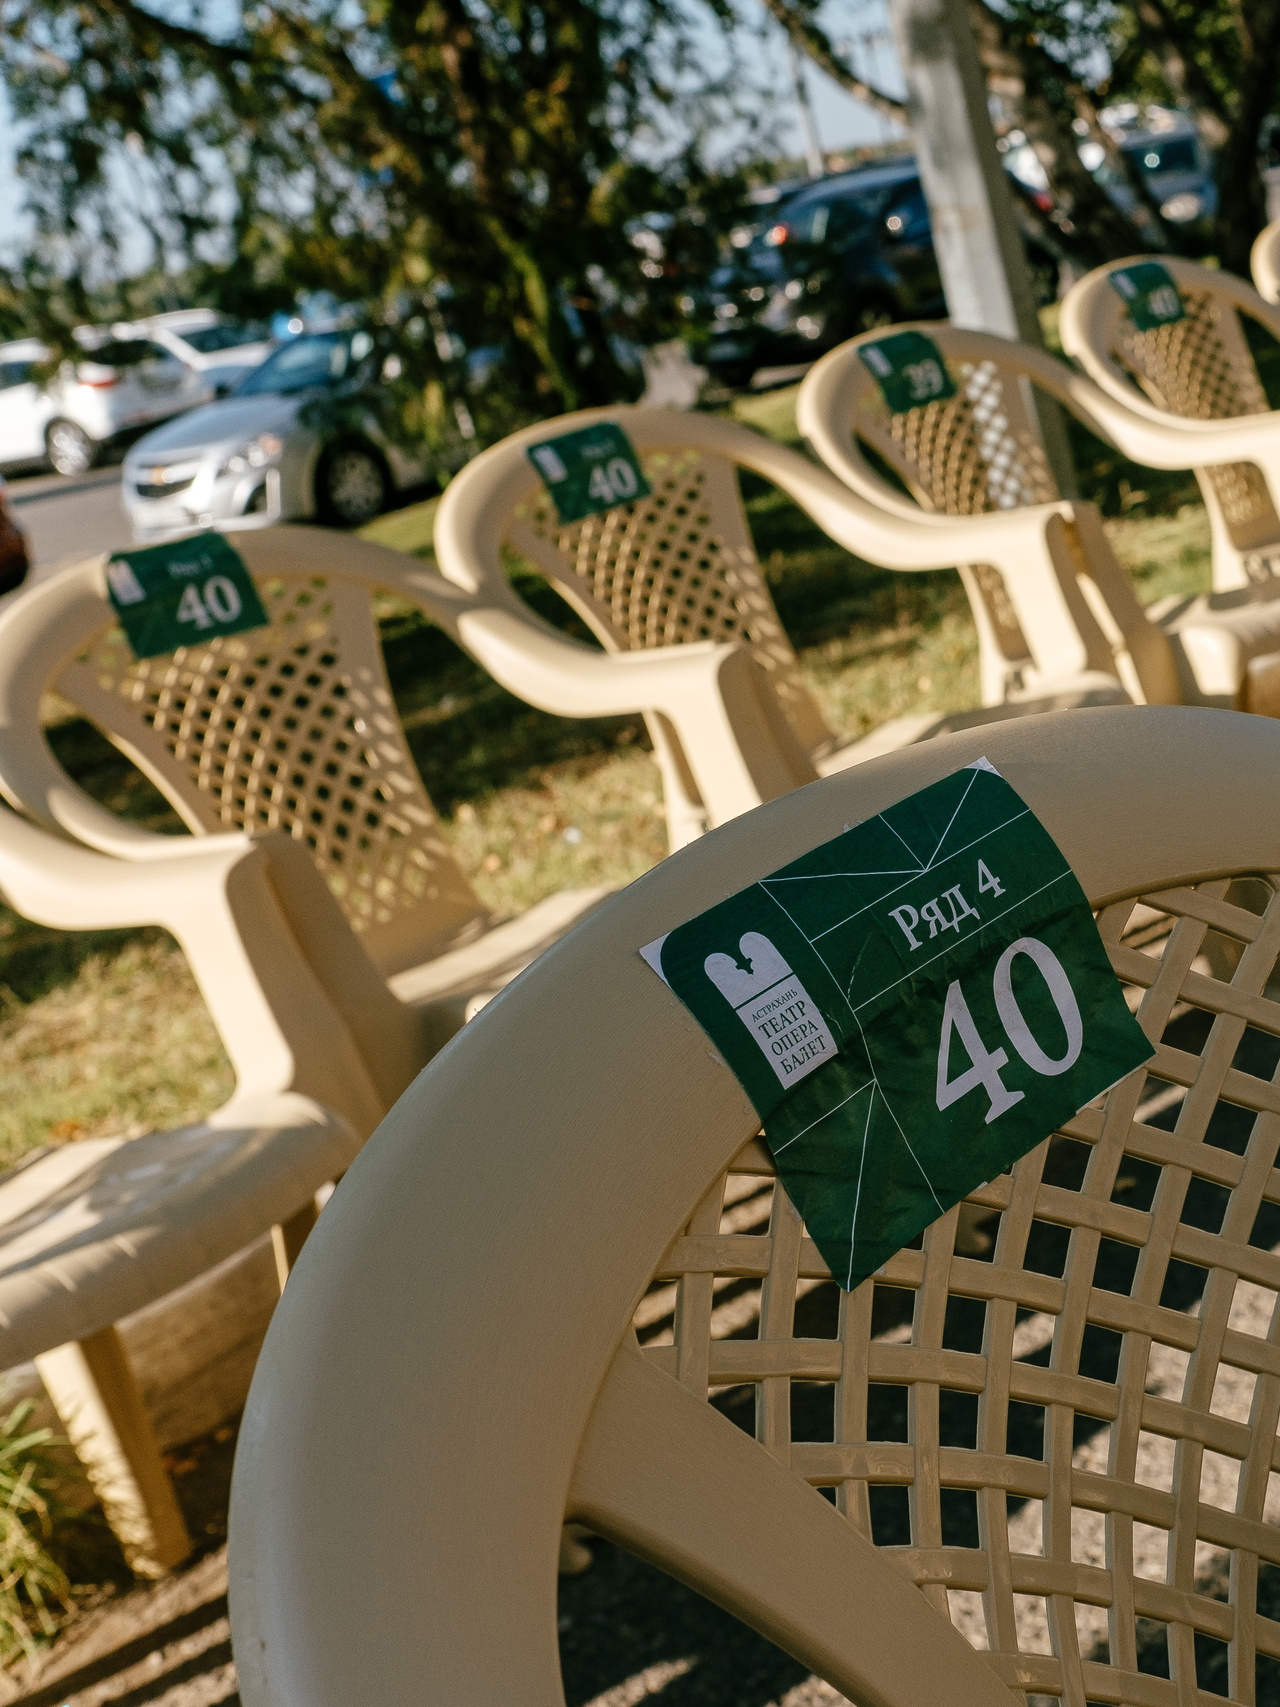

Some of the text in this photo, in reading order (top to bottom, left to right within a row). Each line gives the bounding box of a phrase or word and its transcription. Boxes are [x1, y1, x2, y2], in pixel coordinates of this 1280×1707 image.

[588, 457, 638, 504] 40
[175, 574, 243, 631] 40
[887, 858, 1006, 951] Ряд 4
[751, 989, 798, 1023] АСТРАХАНЬ
[758, 1000, 806, 1039] ТЕАТР
[771, 1019, 819, 1056] ОПЕРА
[935, 936, 1083, 1125] 40
[779, 1034, 827, 1075] БАЛЕТ
